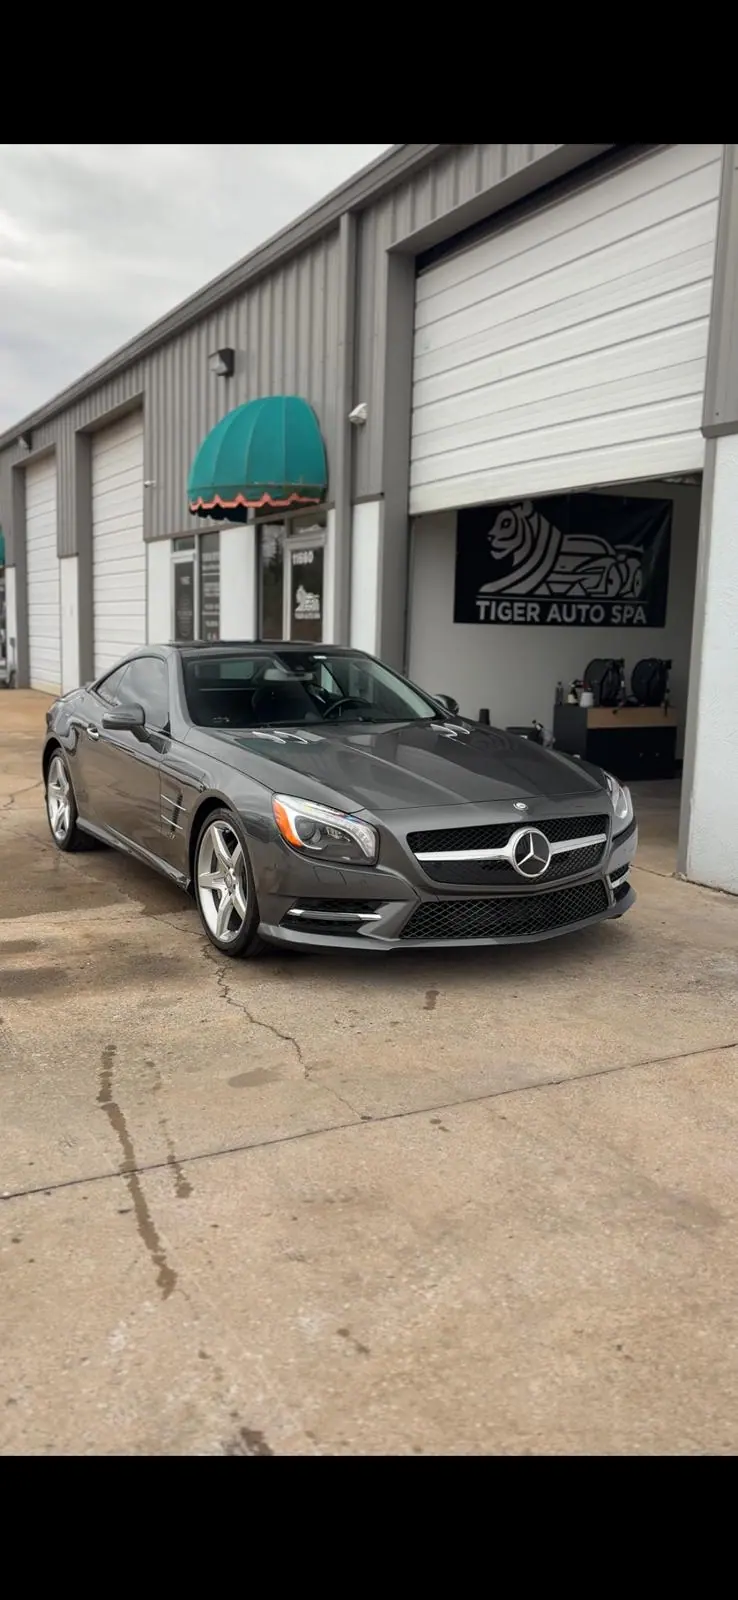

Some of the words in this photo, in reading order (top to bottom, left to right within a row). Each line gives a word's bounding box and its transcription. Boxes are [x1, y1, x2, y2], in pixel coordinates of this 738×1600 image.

[476, 600, 541, 622] TIGER
[546, 603, 605, 623] AUTO
[611, 605, 647, 624] SPA
